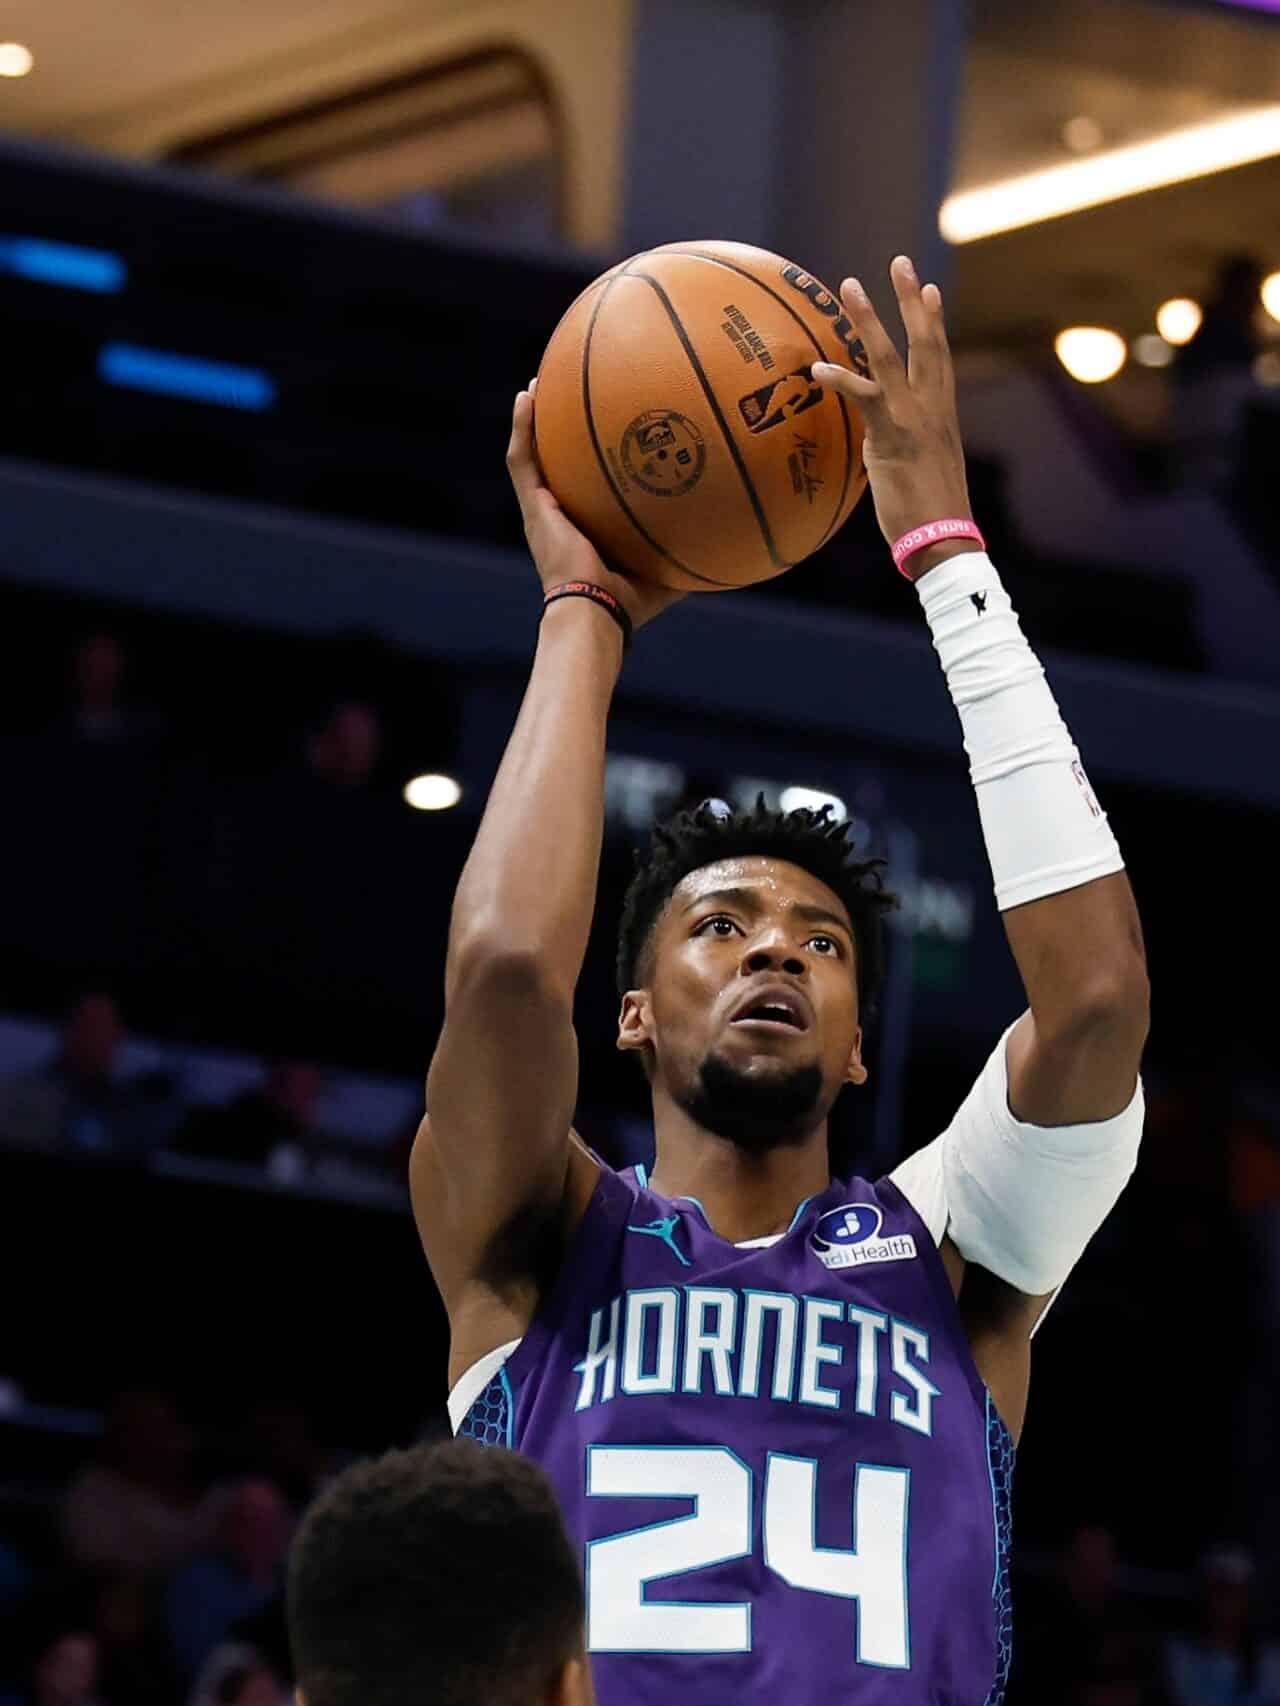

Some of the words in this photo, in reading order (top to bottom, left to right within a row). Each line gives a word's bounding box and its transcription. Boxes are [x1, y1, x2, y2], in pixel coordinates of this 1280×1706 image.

[852, 1239, 912, 1261] Health
[573, 1285, 941, 1436] HORNETS
[586, 1444, 911, 1670] 24
